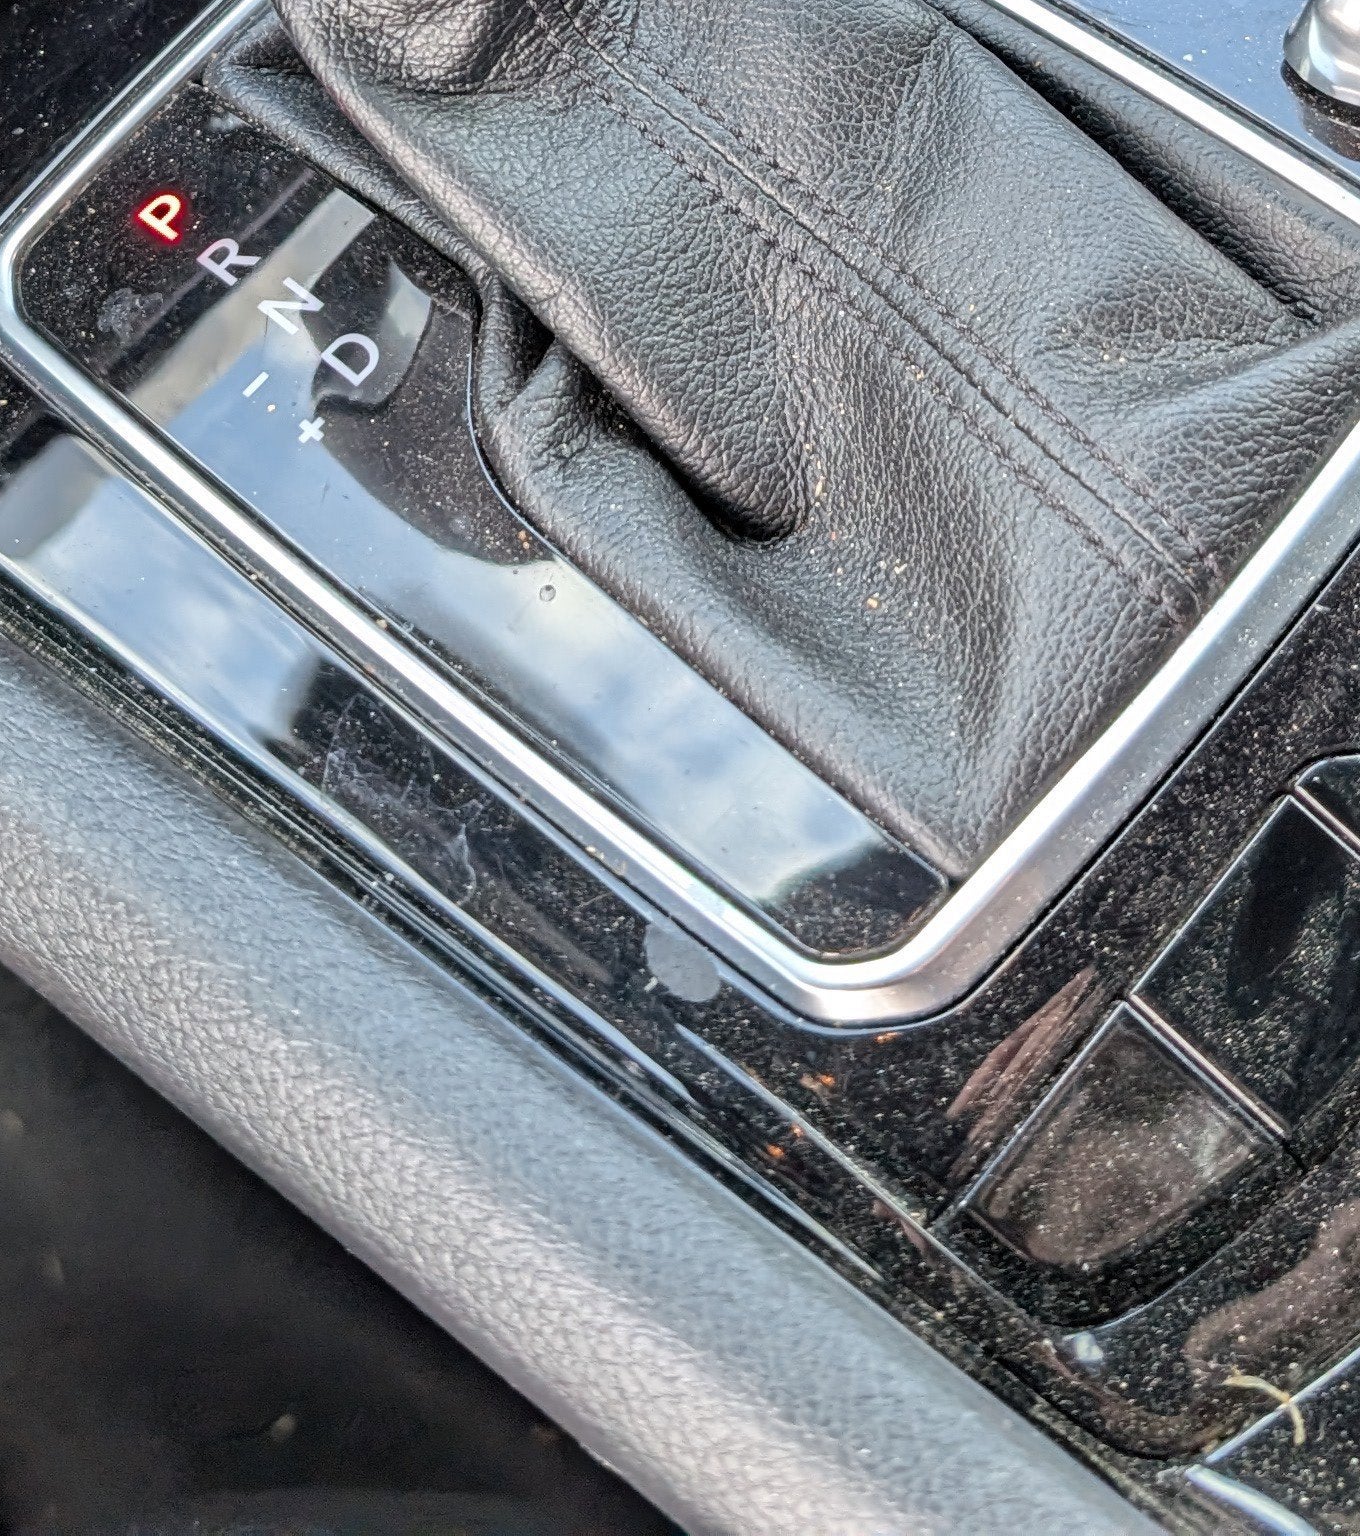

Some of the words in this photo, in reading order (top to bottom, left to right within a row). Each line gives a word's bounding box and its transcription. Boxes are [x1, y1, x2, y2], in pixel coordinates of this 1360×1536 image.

[138, 192, 183, 242] P
[196, 238, 260, 286] R
[258, 276, 324, 334] N
[321, 332, 379, 385] D
